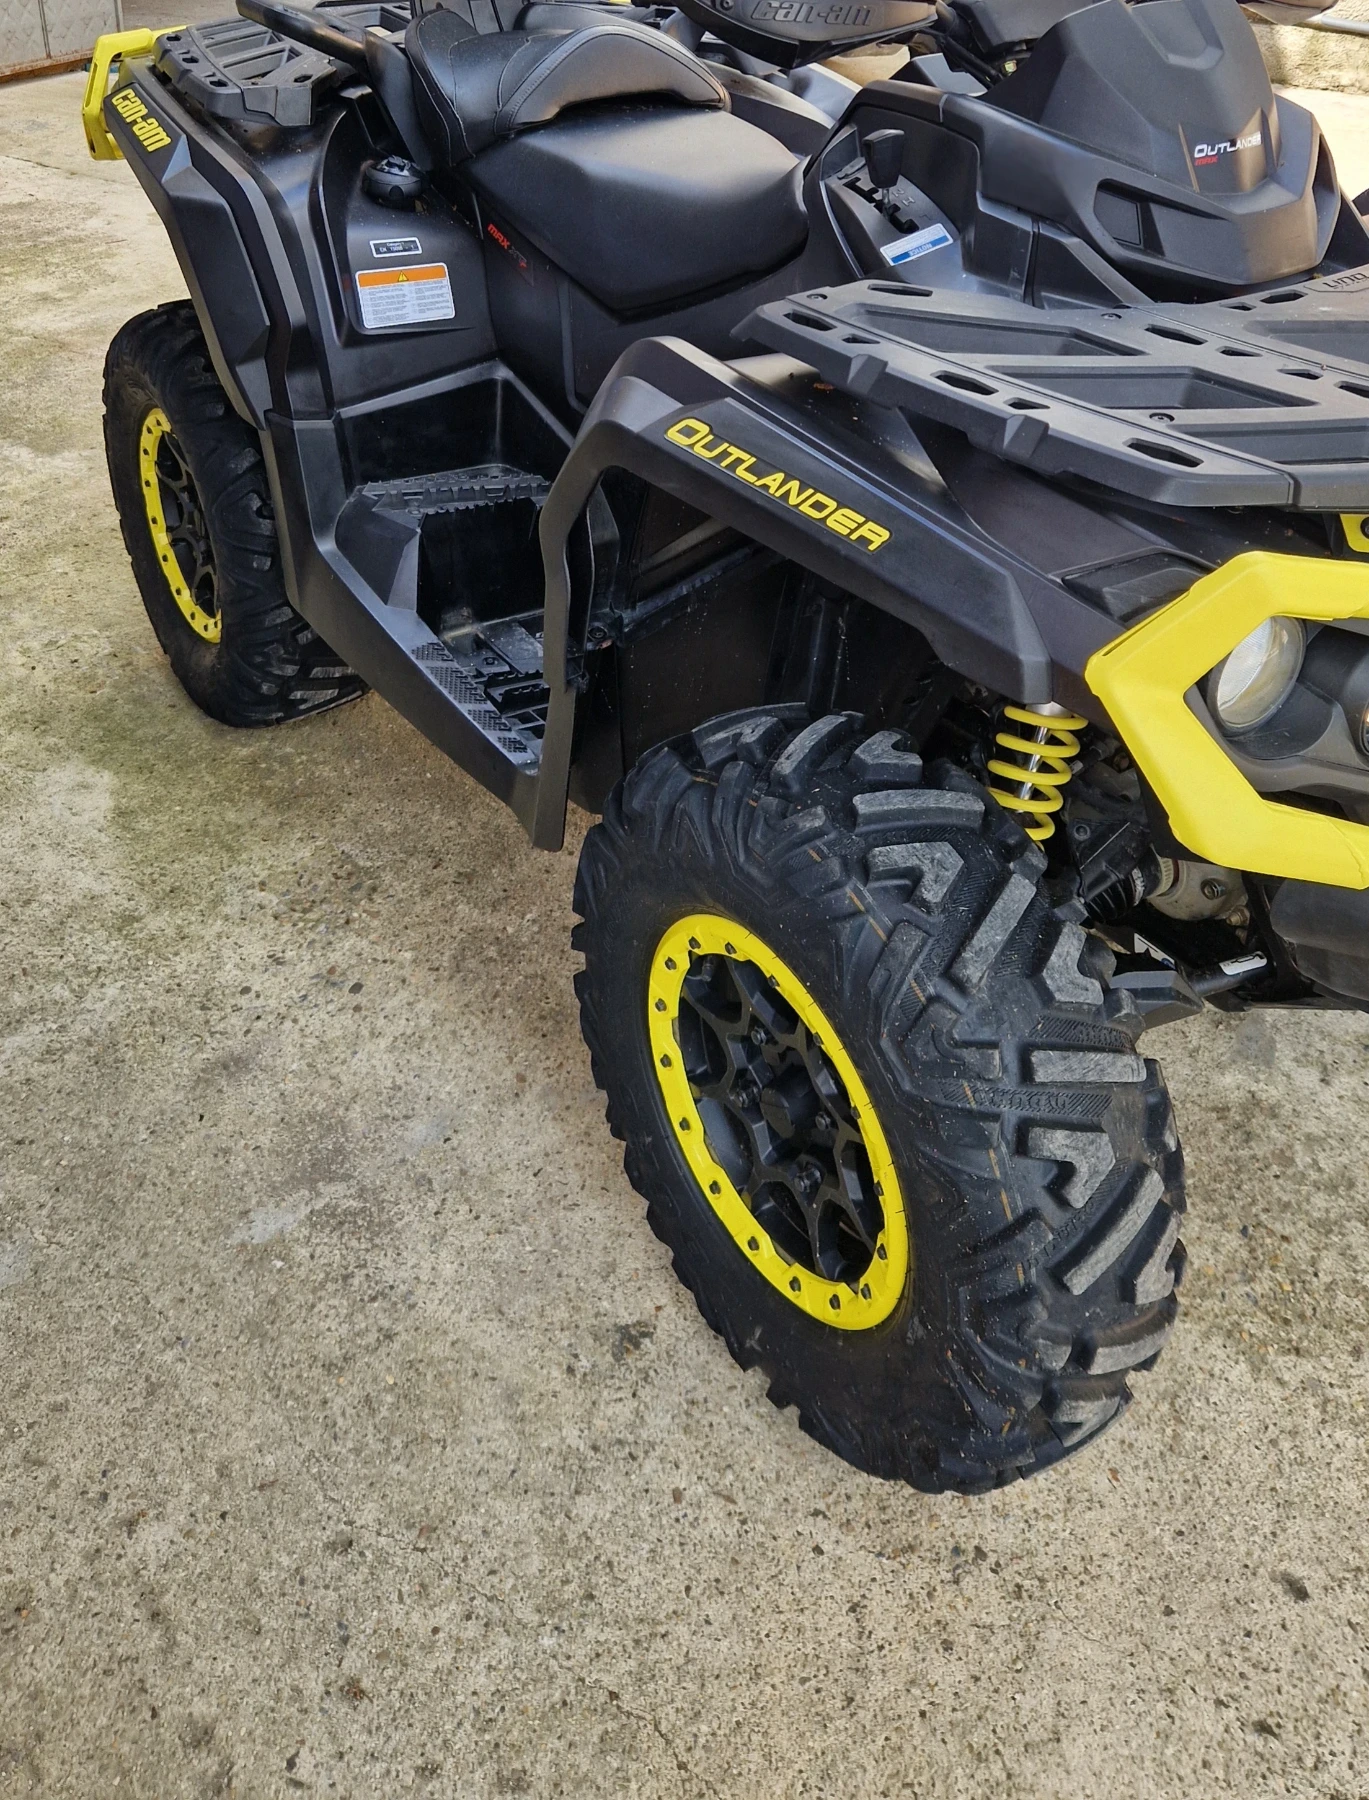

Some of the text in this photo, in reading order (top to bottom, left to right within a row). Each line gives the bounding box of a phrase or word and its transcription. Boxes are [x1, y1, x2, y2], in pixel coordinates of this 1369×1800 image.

[751, 0, 872, 26] can-am
[111, 88, 172, 152] can-am
[1194, 131, 1262, 158] OUTLANDER
[907, 242, 933, 257] NOTICE
[667, 418, 891, 551] OUTLANDER
